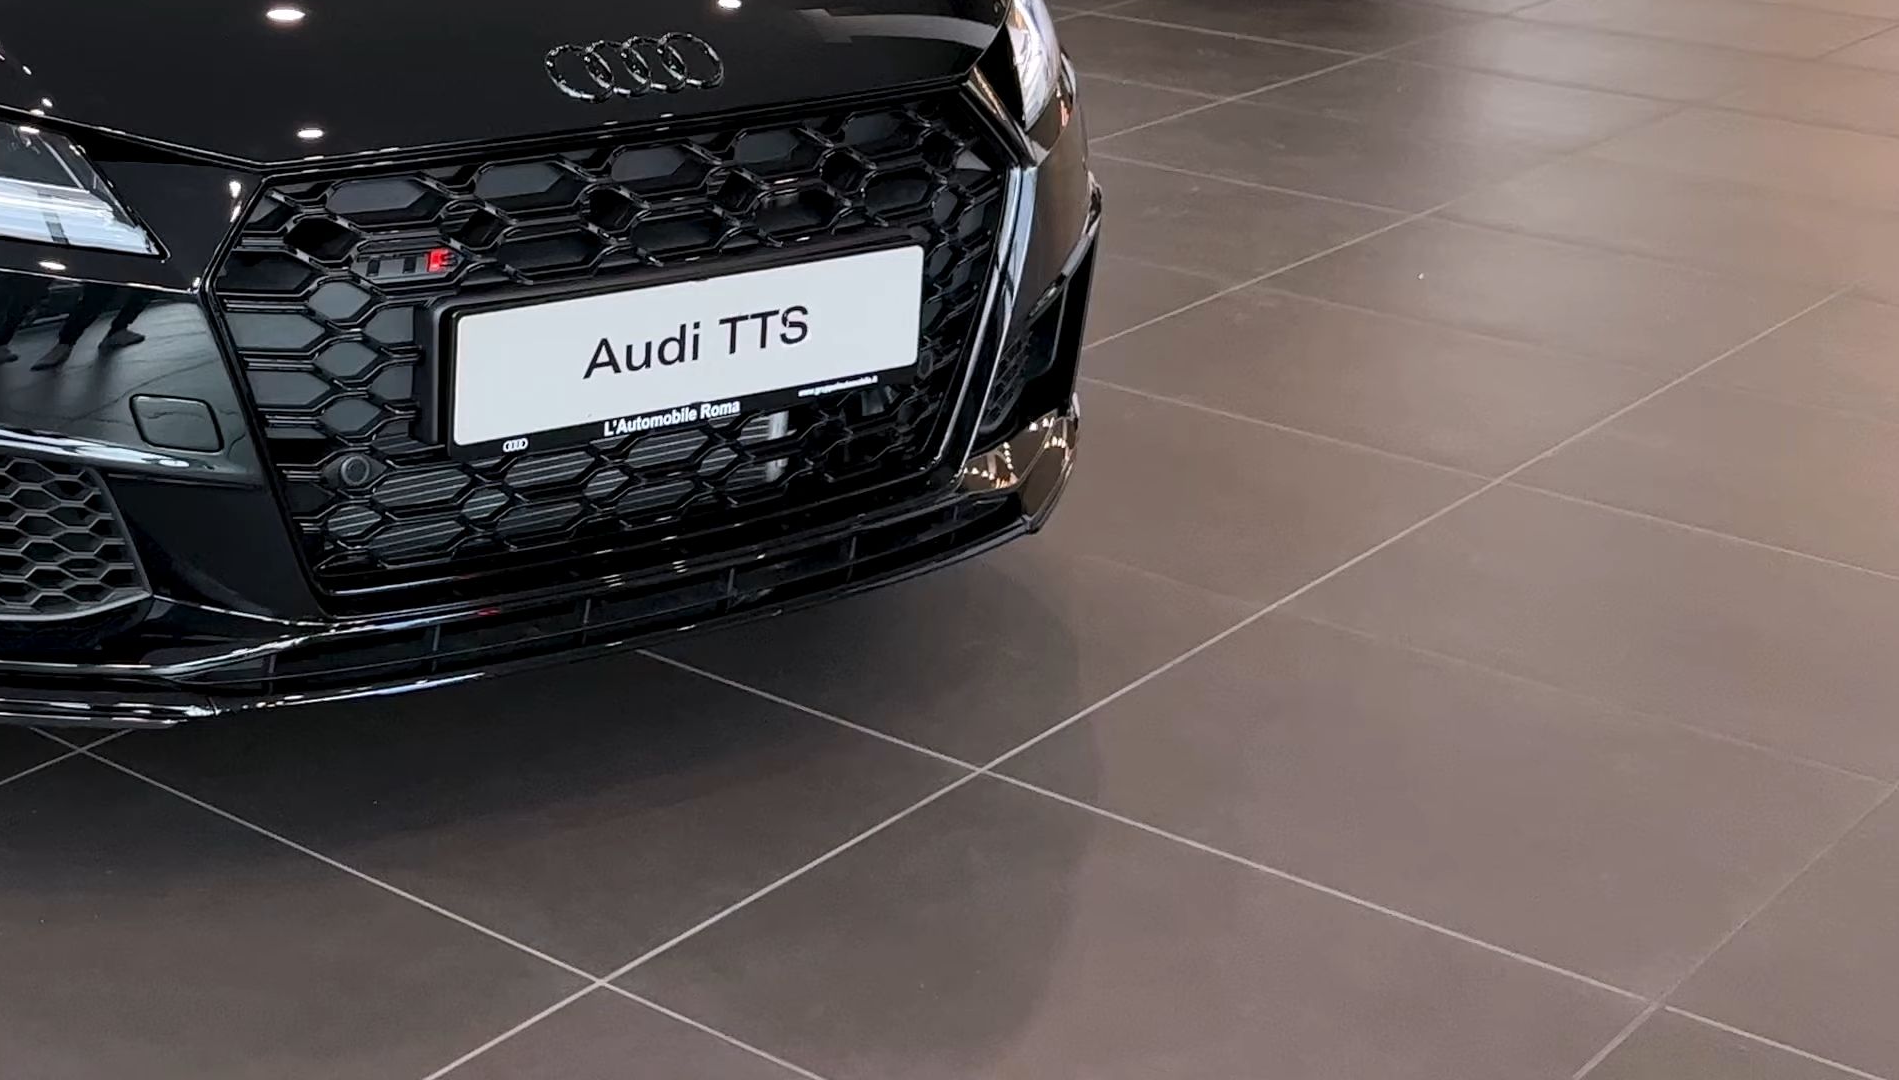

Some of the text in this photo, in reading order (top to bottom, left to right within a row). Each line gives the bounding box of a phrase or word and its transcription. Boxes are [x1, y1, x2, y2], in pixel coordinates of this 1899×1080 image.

[583, 305, 809, 379] Audi TTS
[603, 400, 741, 437] L'Automobile Roma
